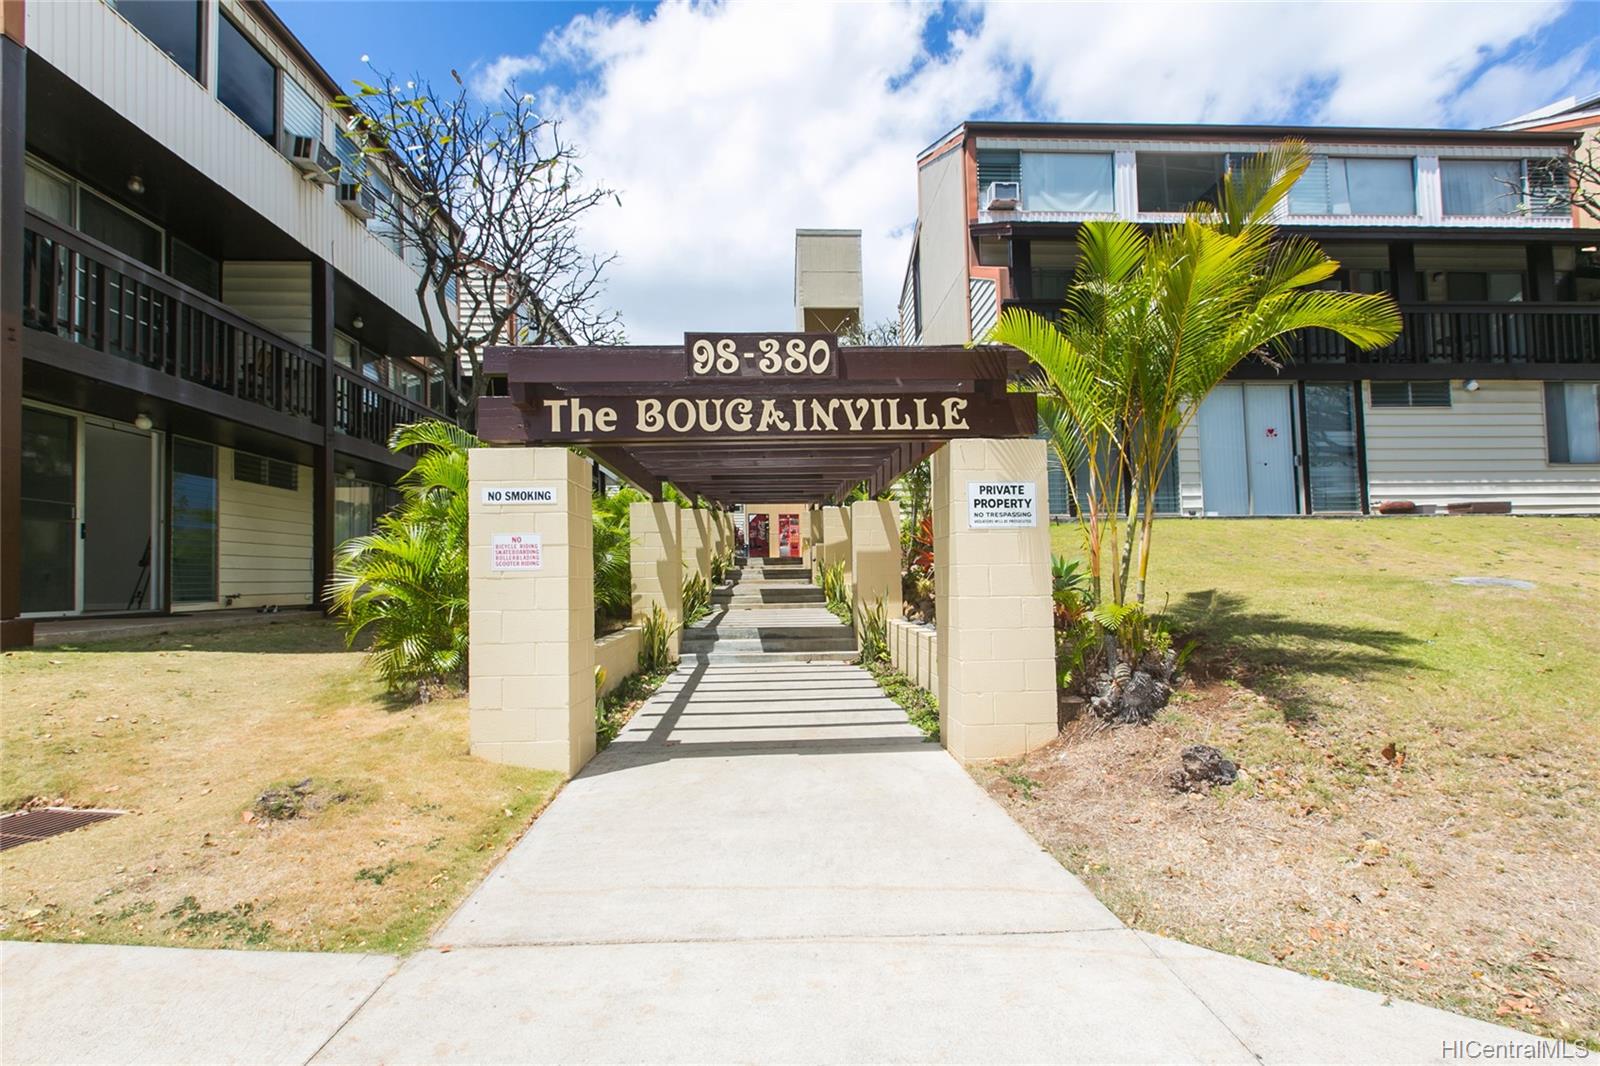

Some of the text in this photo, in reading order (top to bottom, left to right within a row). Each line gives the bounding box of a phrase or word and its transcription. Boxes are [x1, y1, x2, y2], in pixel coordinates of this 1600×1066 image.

[692, 338, 831, 375] 98-380
[543, 397, 970, 433] The BOUGAINVILLE
[979, 485, 1025, 495] PRIVATE
[487, 491, 552, 501] NO SMOKING
[973, 498, 1032, 508] PROPERTY
